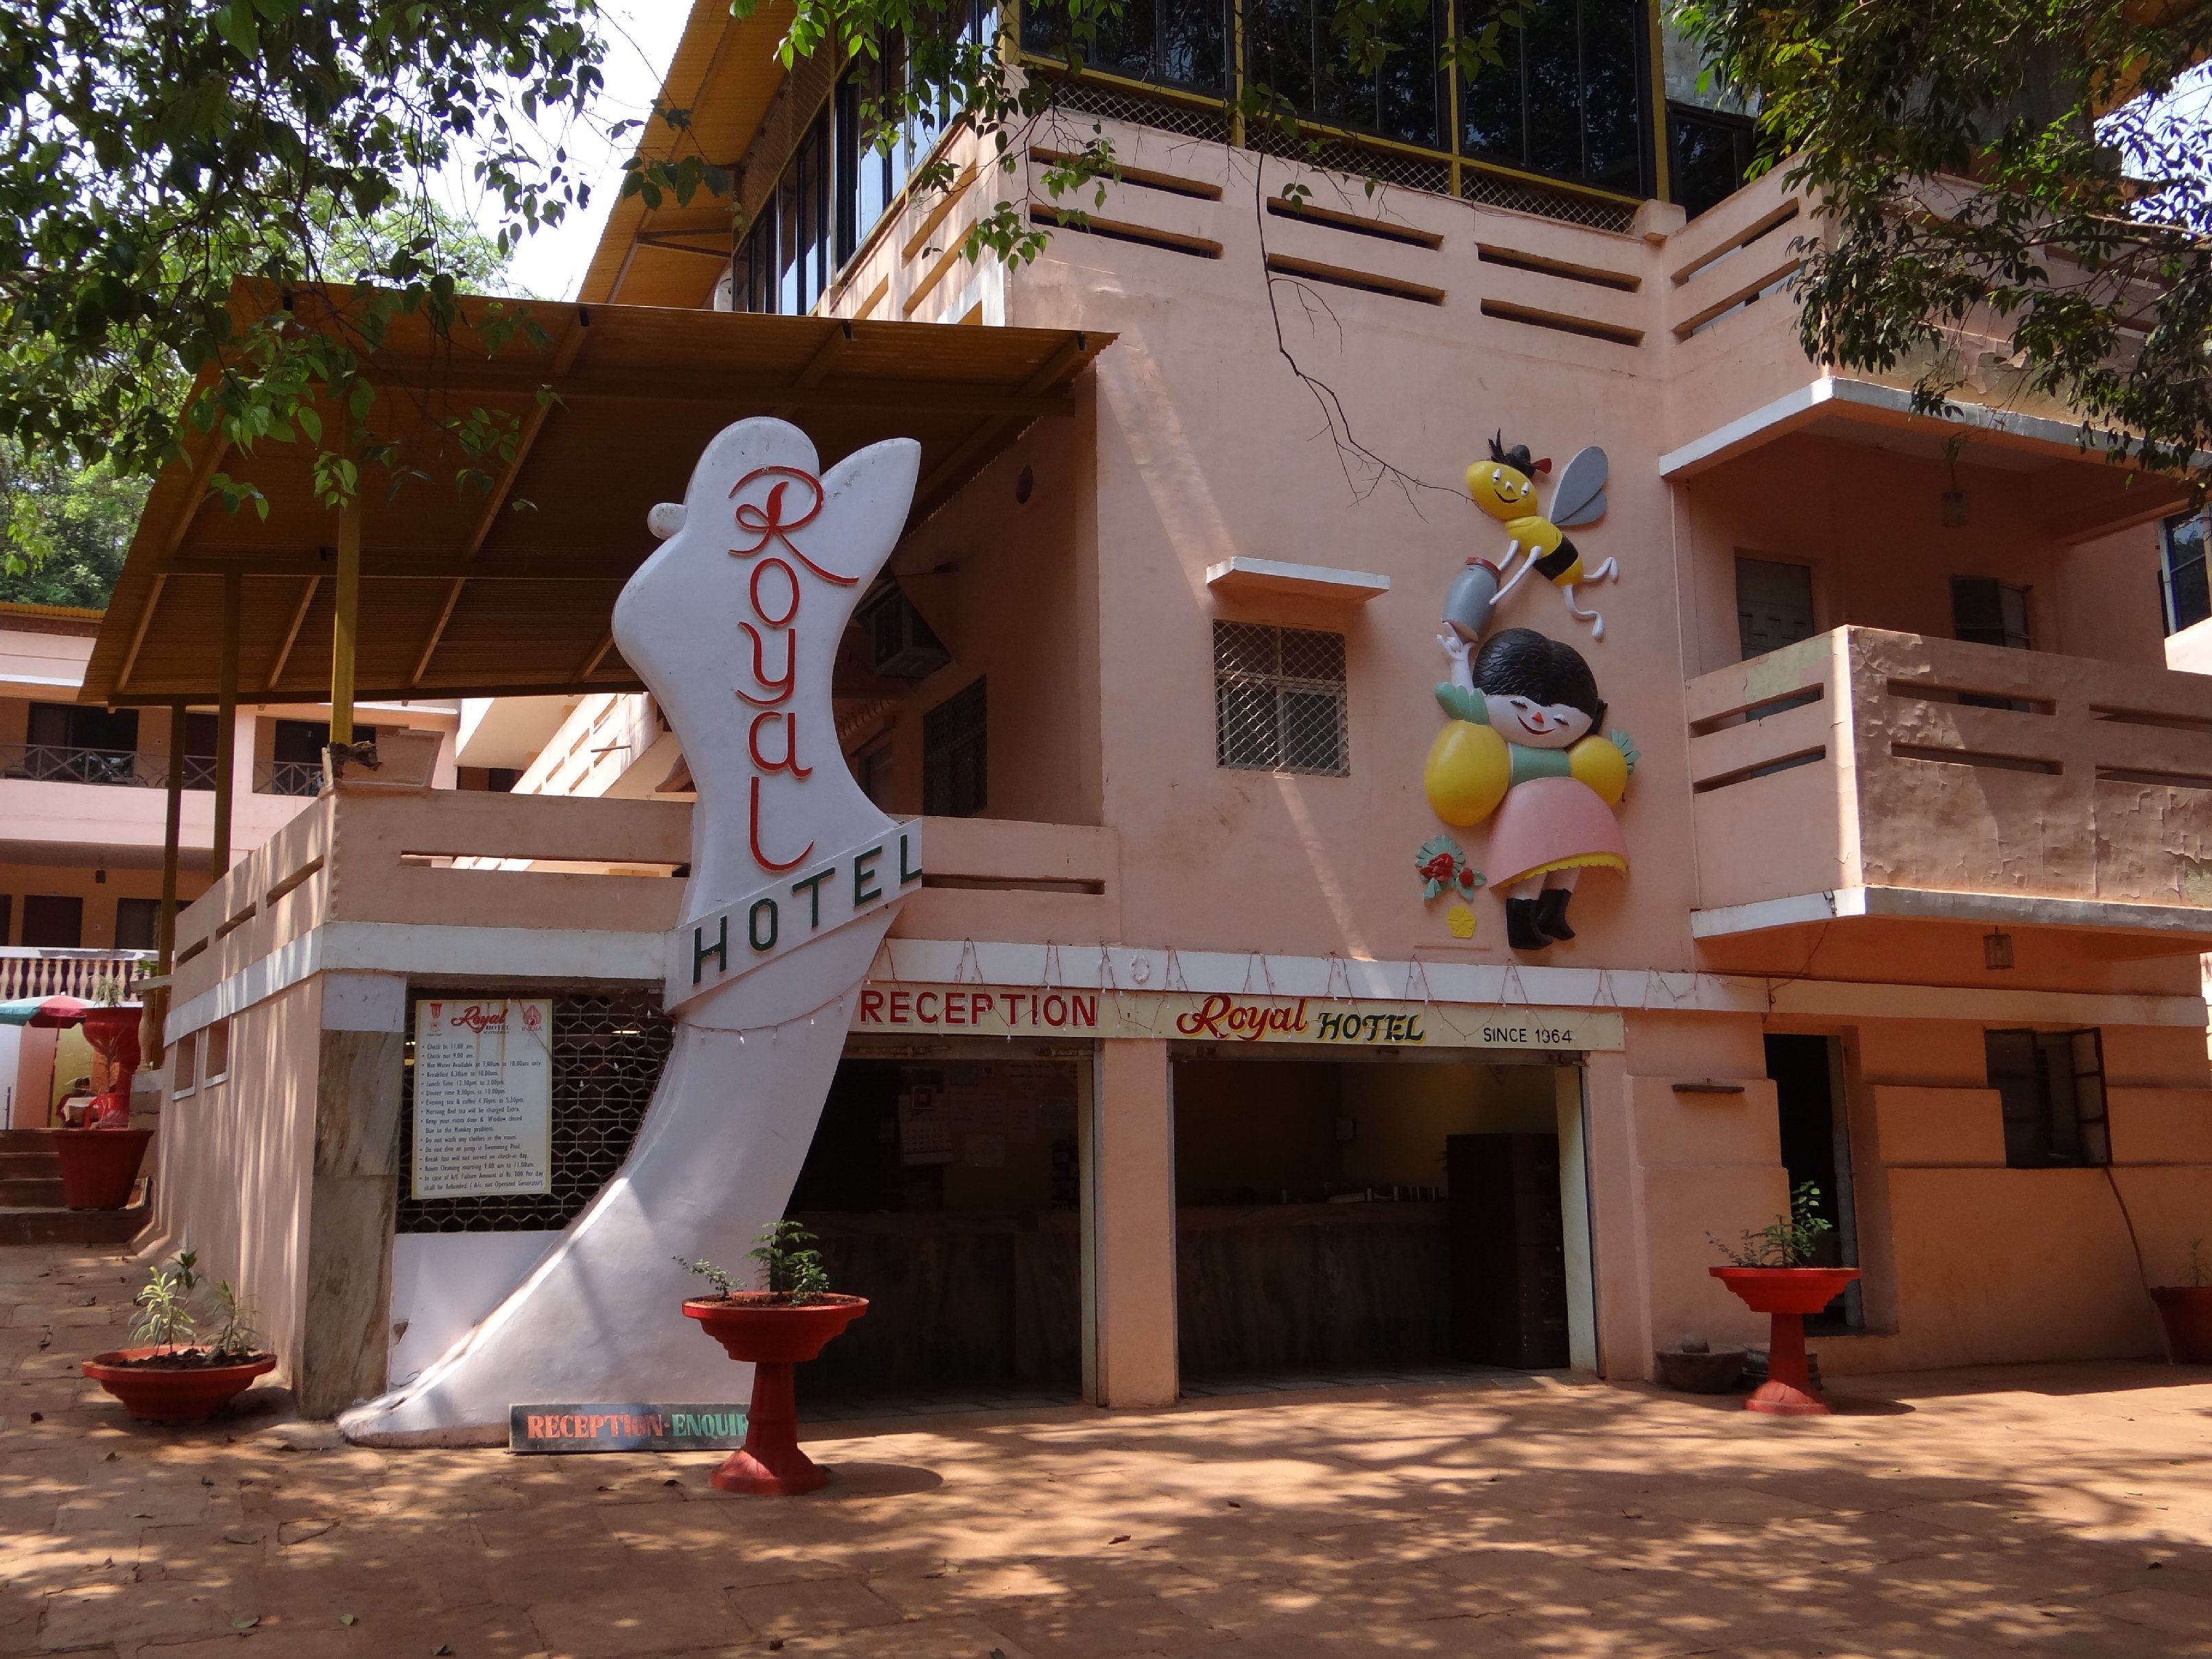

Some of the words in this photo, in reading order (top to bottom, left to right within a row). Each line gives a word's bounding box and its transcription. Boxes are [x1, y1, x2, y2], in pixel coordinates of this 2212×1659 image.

[729, 466, 858, 873] Royal
[693, 834, 922, 986] HOTEL
[451, 1005, 508, 1034] Royal
[861, 990, 1096, 1027] RECEPTION
[1176, 994, 1309, 1041] Royal
[1317, 1012, 1425, 1041] HOTEL
[1484, 1027, 1527, 1042] SINCE
[1535, 1029, 1572, 1043] 1964
[527, 1413, 749, 1438] RECEPTION-ENQUIR
